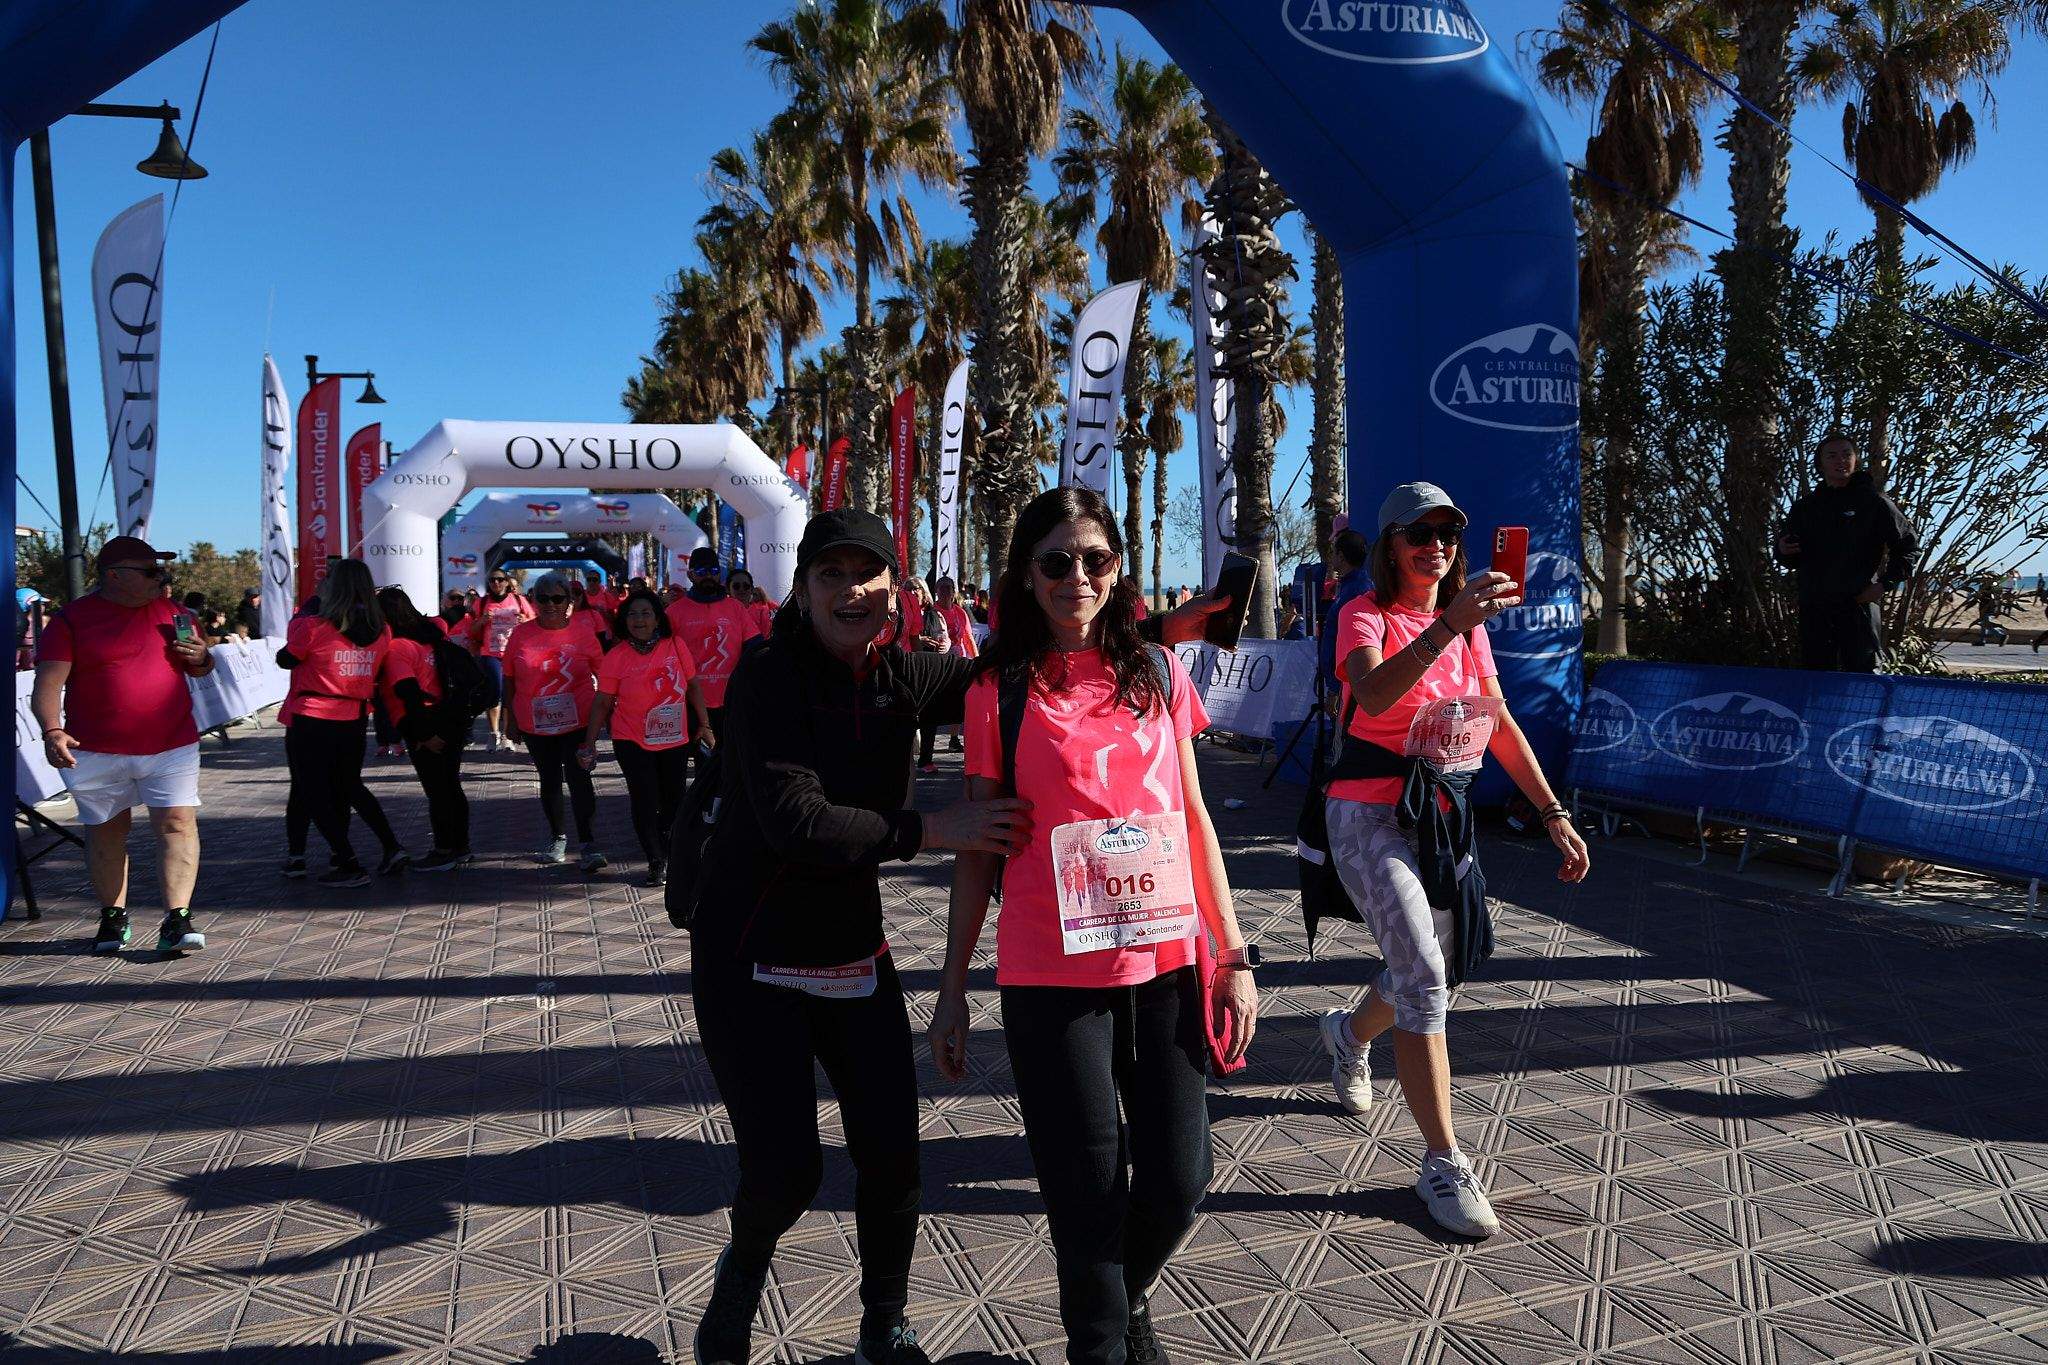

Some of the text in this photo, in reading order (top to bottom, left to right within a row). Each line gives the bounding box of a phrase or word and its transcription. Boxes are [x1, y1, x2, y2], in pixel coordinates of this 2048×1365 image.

[1299, 0, 1482, 43] ASTURIANA
[1485, 361, 1550, 372] CENTRAL
[109, 272, 159, 537] YSHO
[310, 408, 328, 511] Santander
[504, 435, 683, 471] OYSHO
[394, 474, 450, 486] OYSHO
[730, 474, 780, 486] OYSHO
[369, 544, 423, 556] OYSHO
[512, 545, 586, 553] VOLVO
[760, 542, 799, 554] OYSH
[339, 663, 372, 676] SUMA
[1180, 647, 1273, 692] OYSHO
[546, 712, 564, 720] 016
[1441, 732, 1471, 747] 016
[1660, 716, 1792, 754] ASTURIANA
[1100, 835, 1147, 849] ASTURIANA
[1106, 872, 1155, 897] 016
[1117, 901, 1142, 912] 2653
[1079, 907, 1181, 927] CARRERA DE LA MUJER VALENCIA
[1079, 923, 1184, 944] OYSHO Santander
[771, 966, 798, 976] CARRERA
[799, 968, 808, 976] DE
